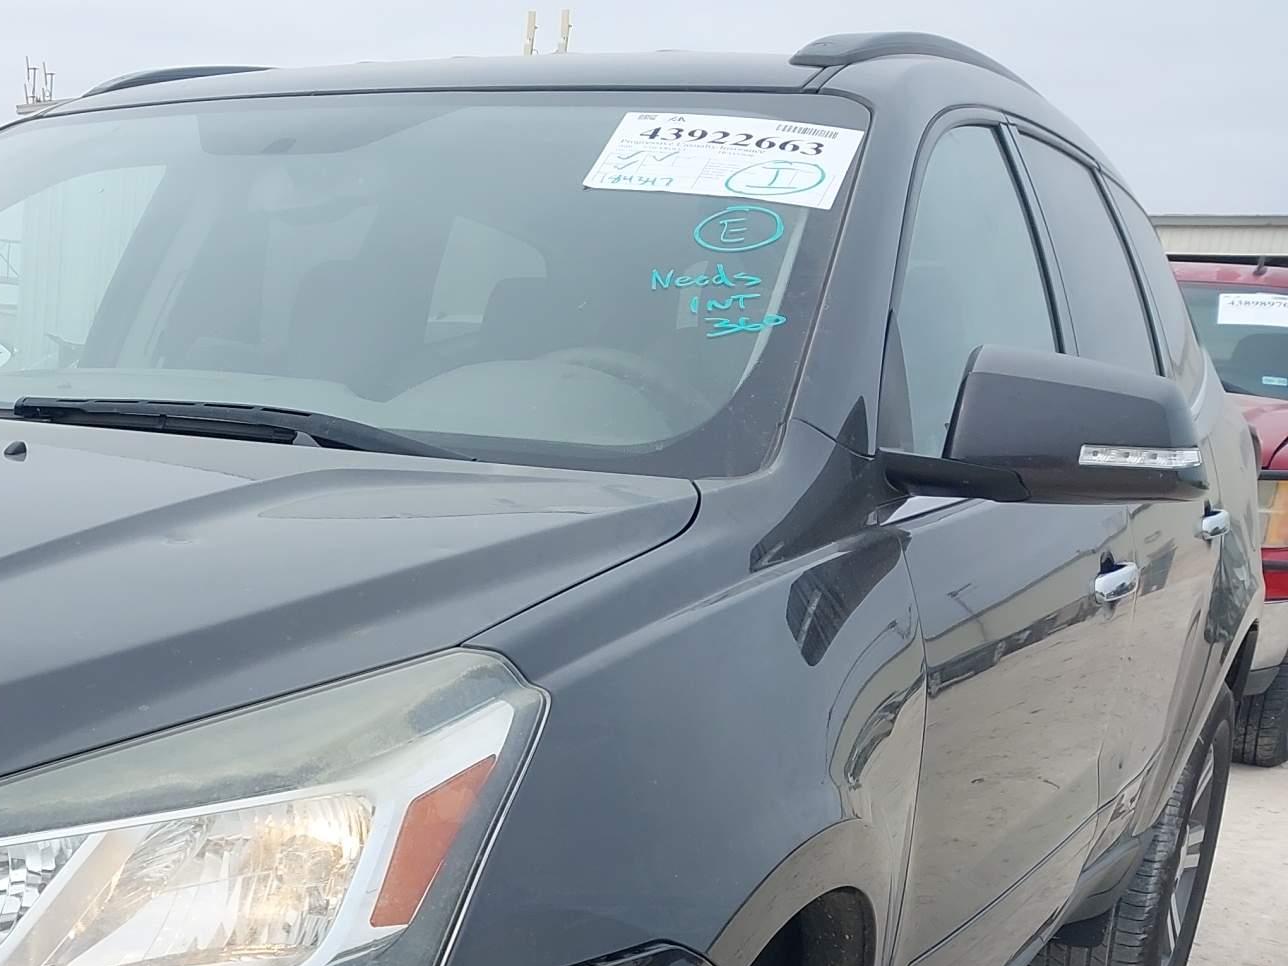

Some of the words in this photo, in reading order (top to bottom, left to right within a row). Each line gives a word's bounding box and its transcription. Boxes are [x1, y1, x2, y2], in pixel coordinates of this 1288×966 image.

[639, 126, 825, 156] 43922663
[719, 217, 748, 243] E
[650, 263, 762, 290] Needs
